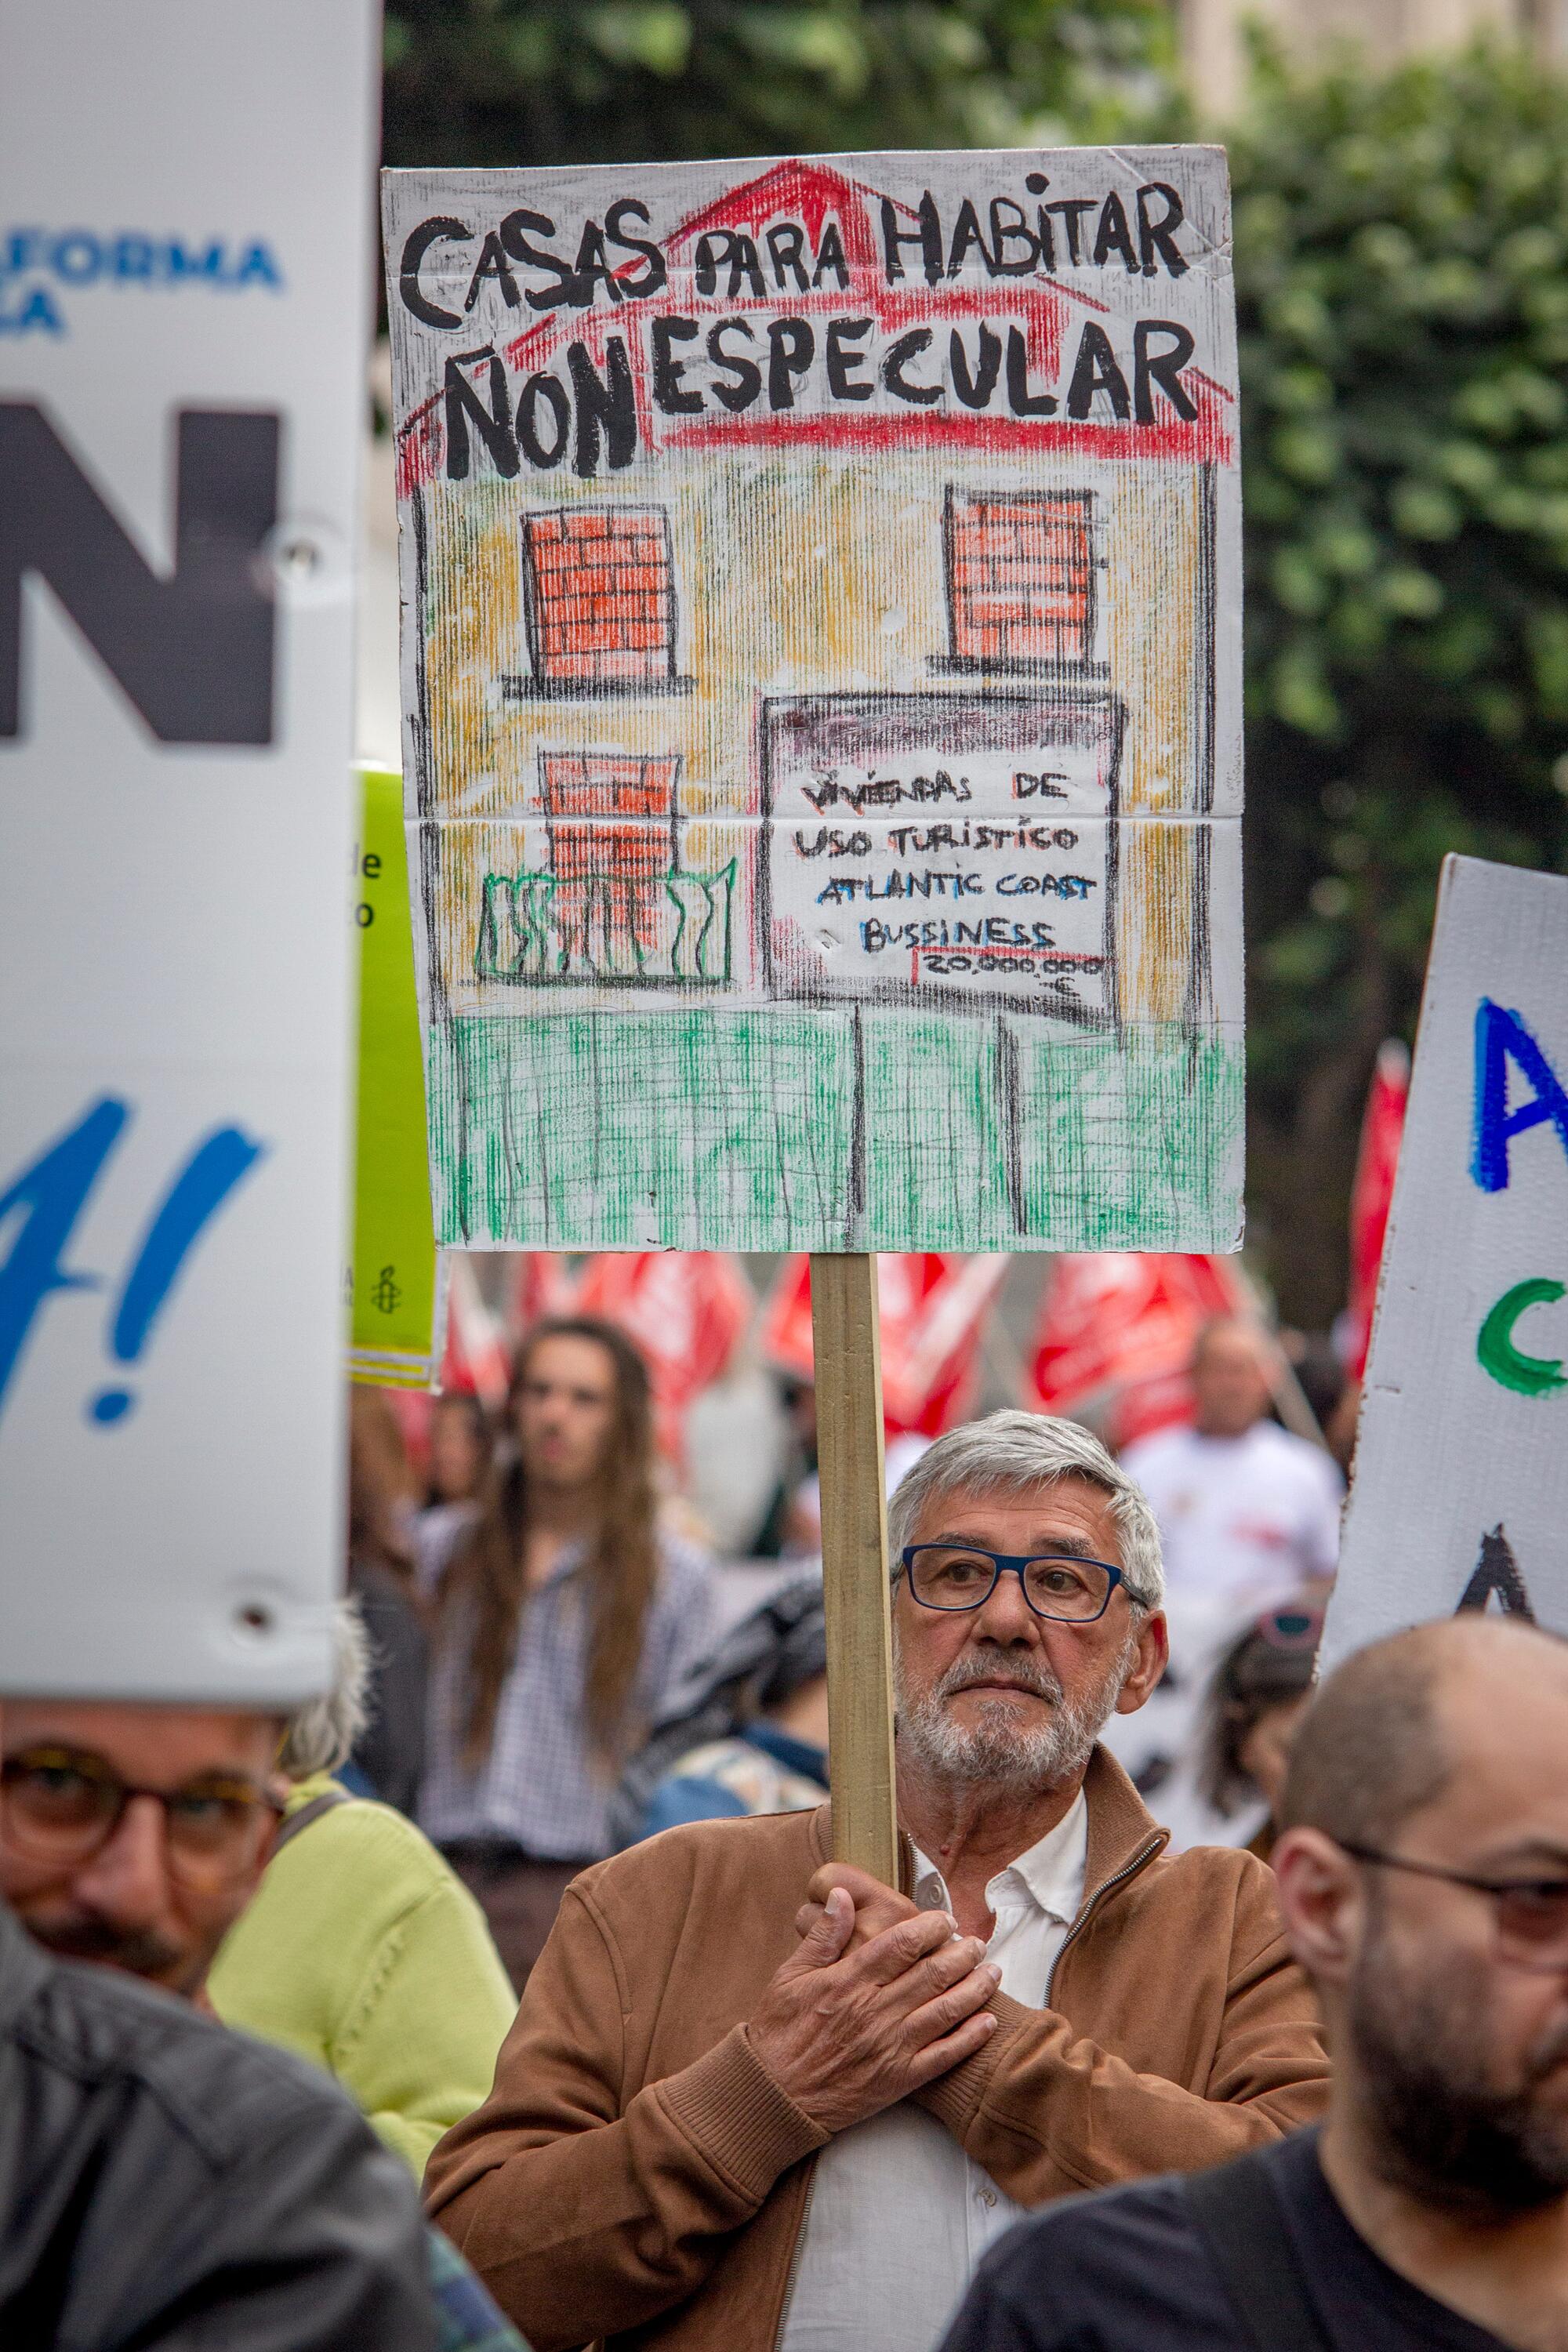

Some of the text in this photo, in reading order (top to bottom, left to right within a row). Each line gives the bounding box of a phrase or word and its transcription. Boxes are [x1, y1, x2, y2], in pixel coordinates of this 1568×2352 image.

[0, 228, 281, 290] FORMA
[400, 198, 667, 329] CASAS
[695, 229, 851, 297] PARA
[651, 316, 1198, 424] ESPECULAR
[1012, 772, 1069, 800] DE
[792, 825, 873, 859] USO
[996, 874, 1098, 899] COAST
